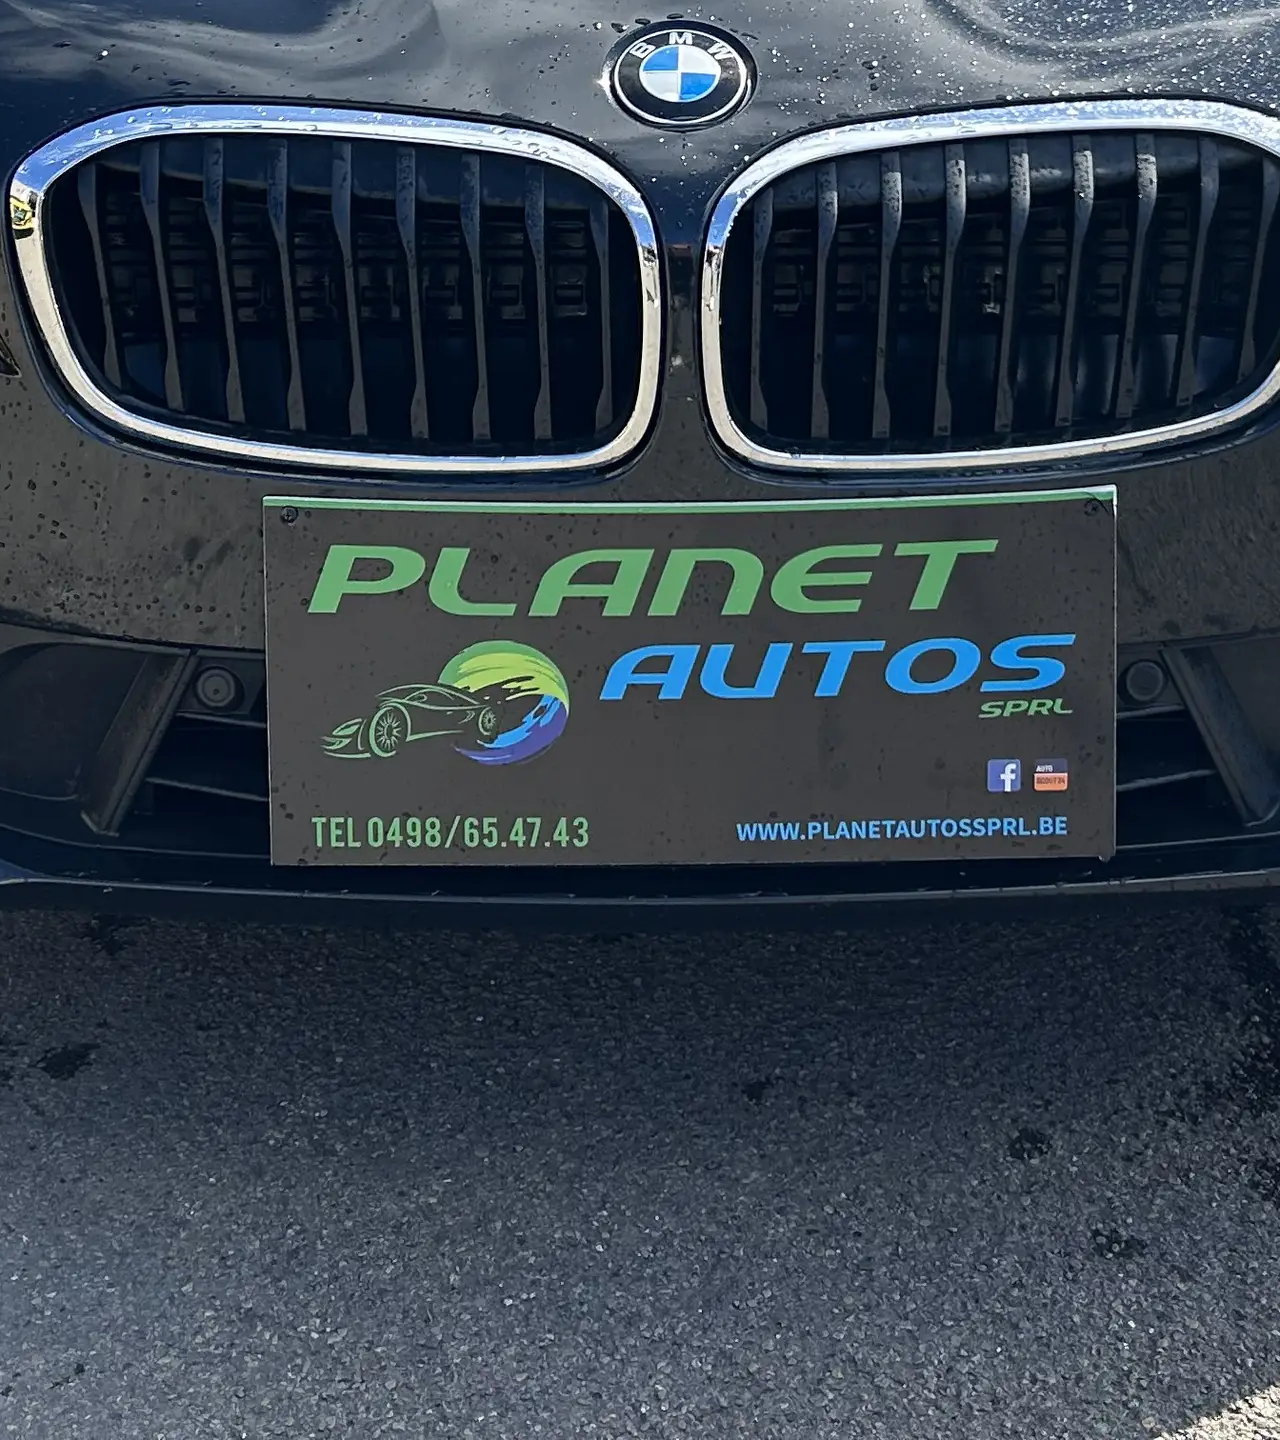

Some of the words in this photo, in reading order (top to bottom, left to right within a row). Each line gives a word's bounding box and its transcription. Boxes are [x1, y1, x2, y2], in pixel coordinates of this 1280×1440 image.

[629, 31, 736, 60] BMW
[308, 539, 999, 618] PLANET
[599, 633, 1077, 701] AUTOS
[977, 697, 1074, 719] SPRL
[311, 816, 362, 848] TEL
[367, 815, 590, 849] 0498/65.47.43
[735, 815, 1069, 843] WWW.PLANETAUTOSSPRL.BE
